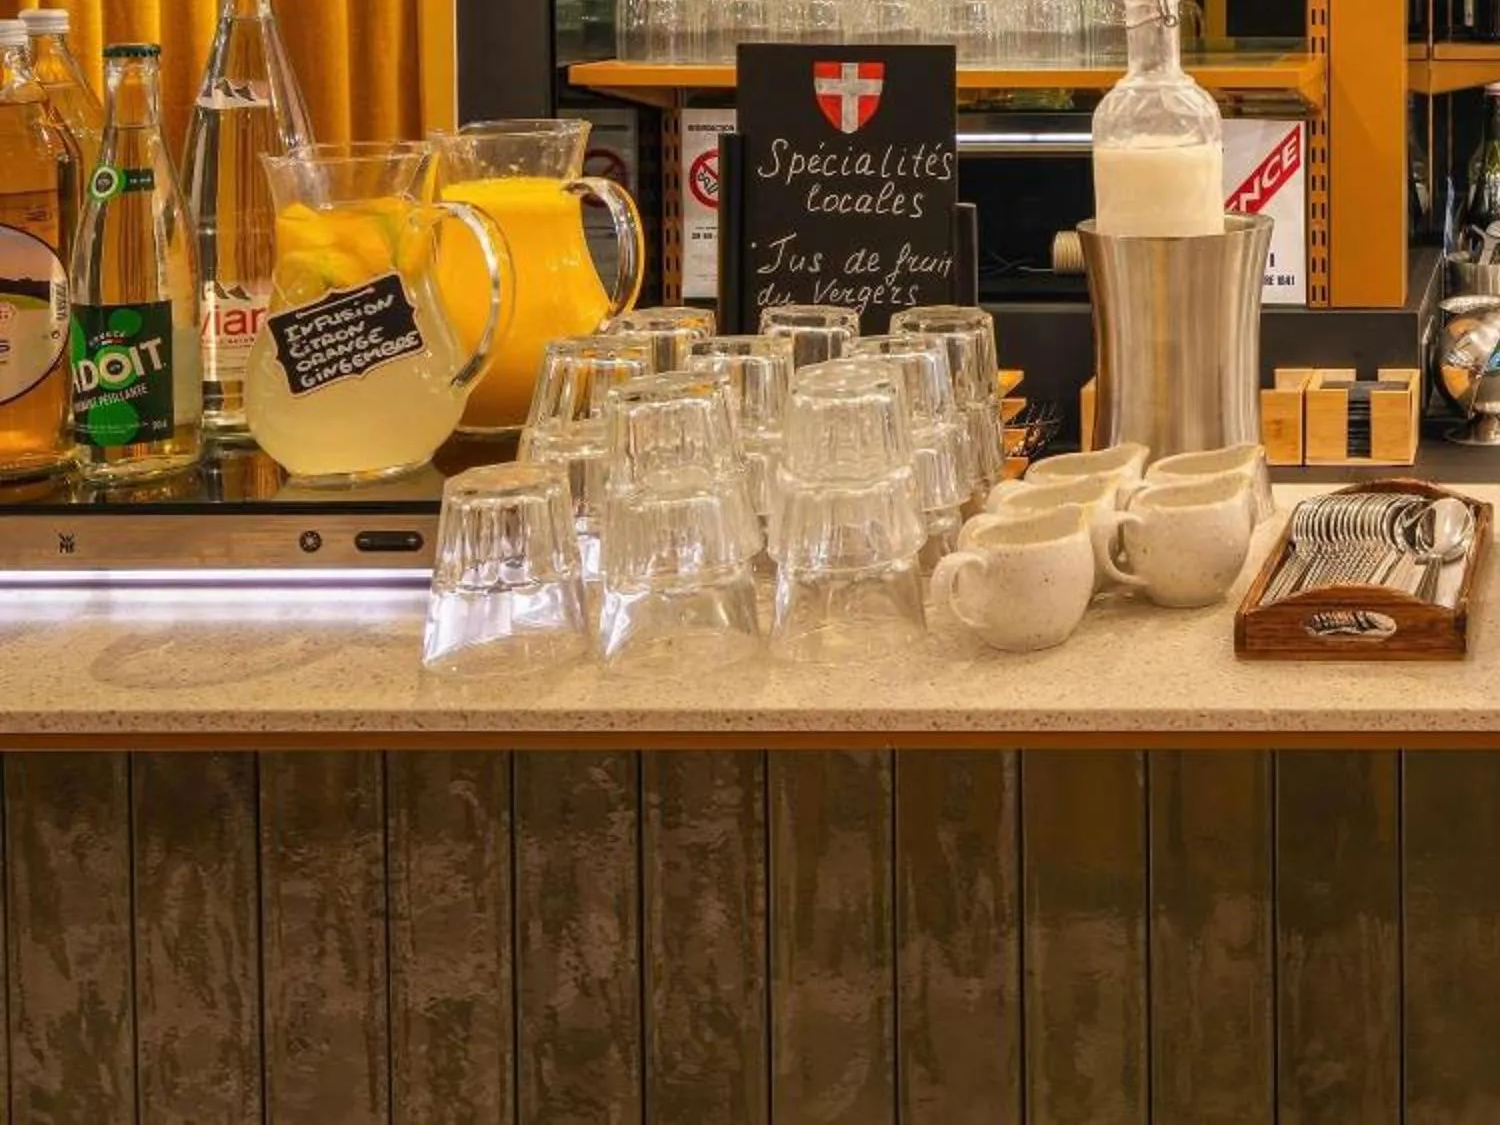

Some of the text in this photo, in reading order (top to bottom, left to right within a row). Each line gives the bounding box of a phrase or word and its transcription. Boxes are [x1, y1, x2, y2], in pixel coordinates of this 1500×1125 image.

[757, 138, 953, 185] Spécialités
[807, 181, 925, 218] locales
[843, 248, 881, 274] de
[296, 326, 385, 372] ORANGE
